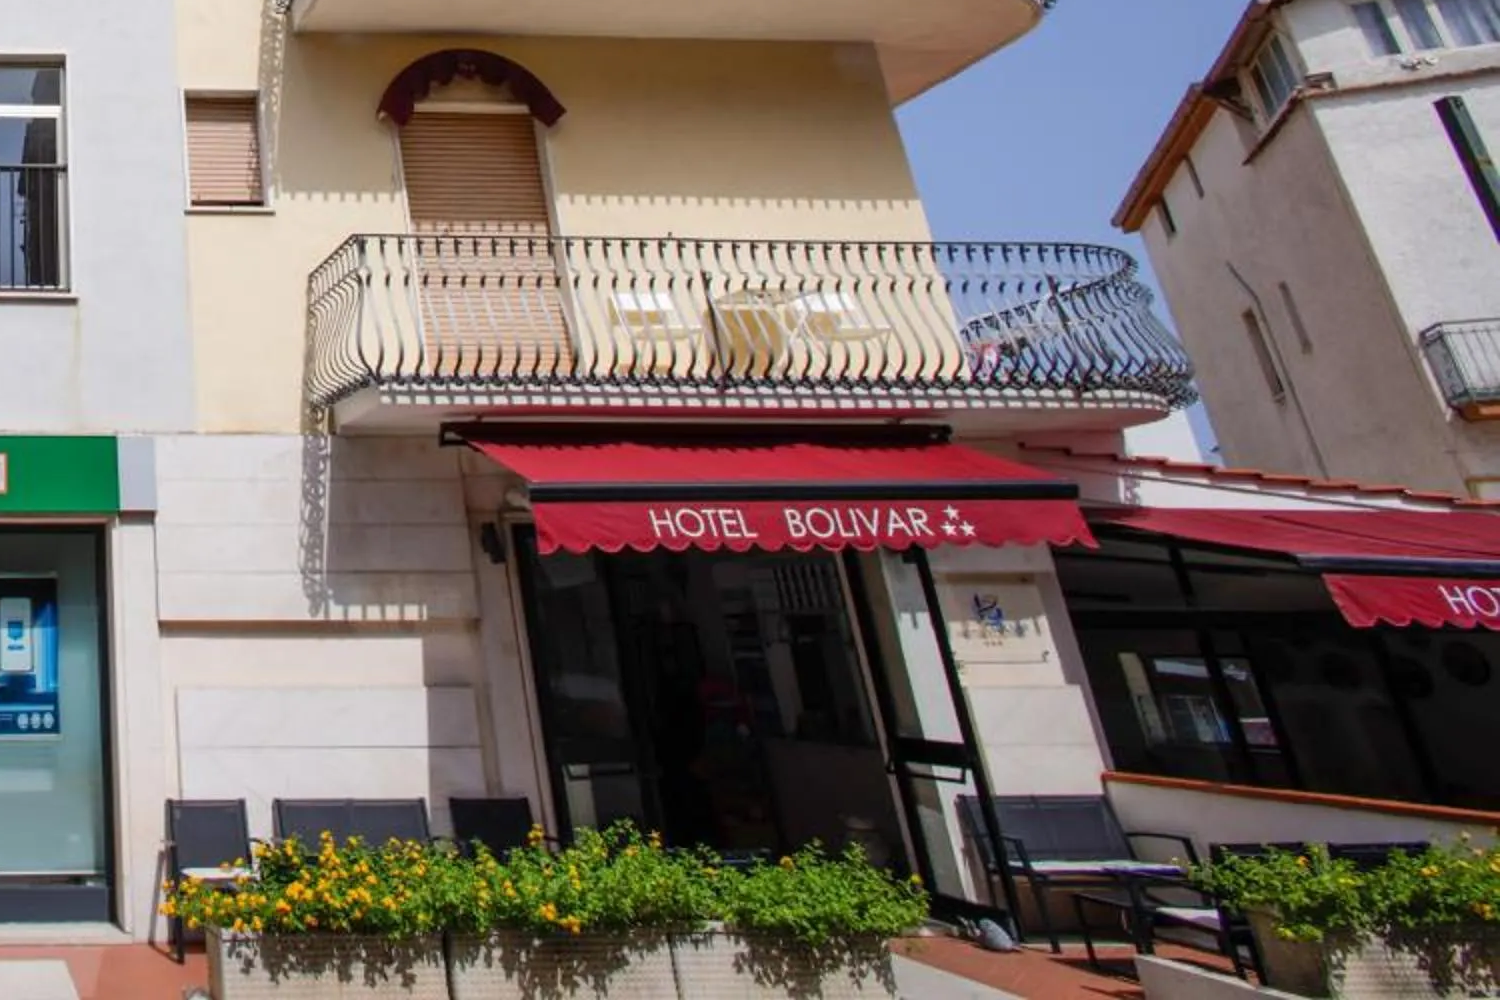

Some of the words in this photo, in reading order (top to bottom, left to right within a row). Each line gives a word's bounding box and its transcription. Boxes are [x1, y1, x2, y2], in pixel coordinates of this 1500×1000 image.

[649, 507, 758, 538] HOTEL
[783, 507, 936, 538] BOLIVAR
[1437, 584, 1500, 617] HO
